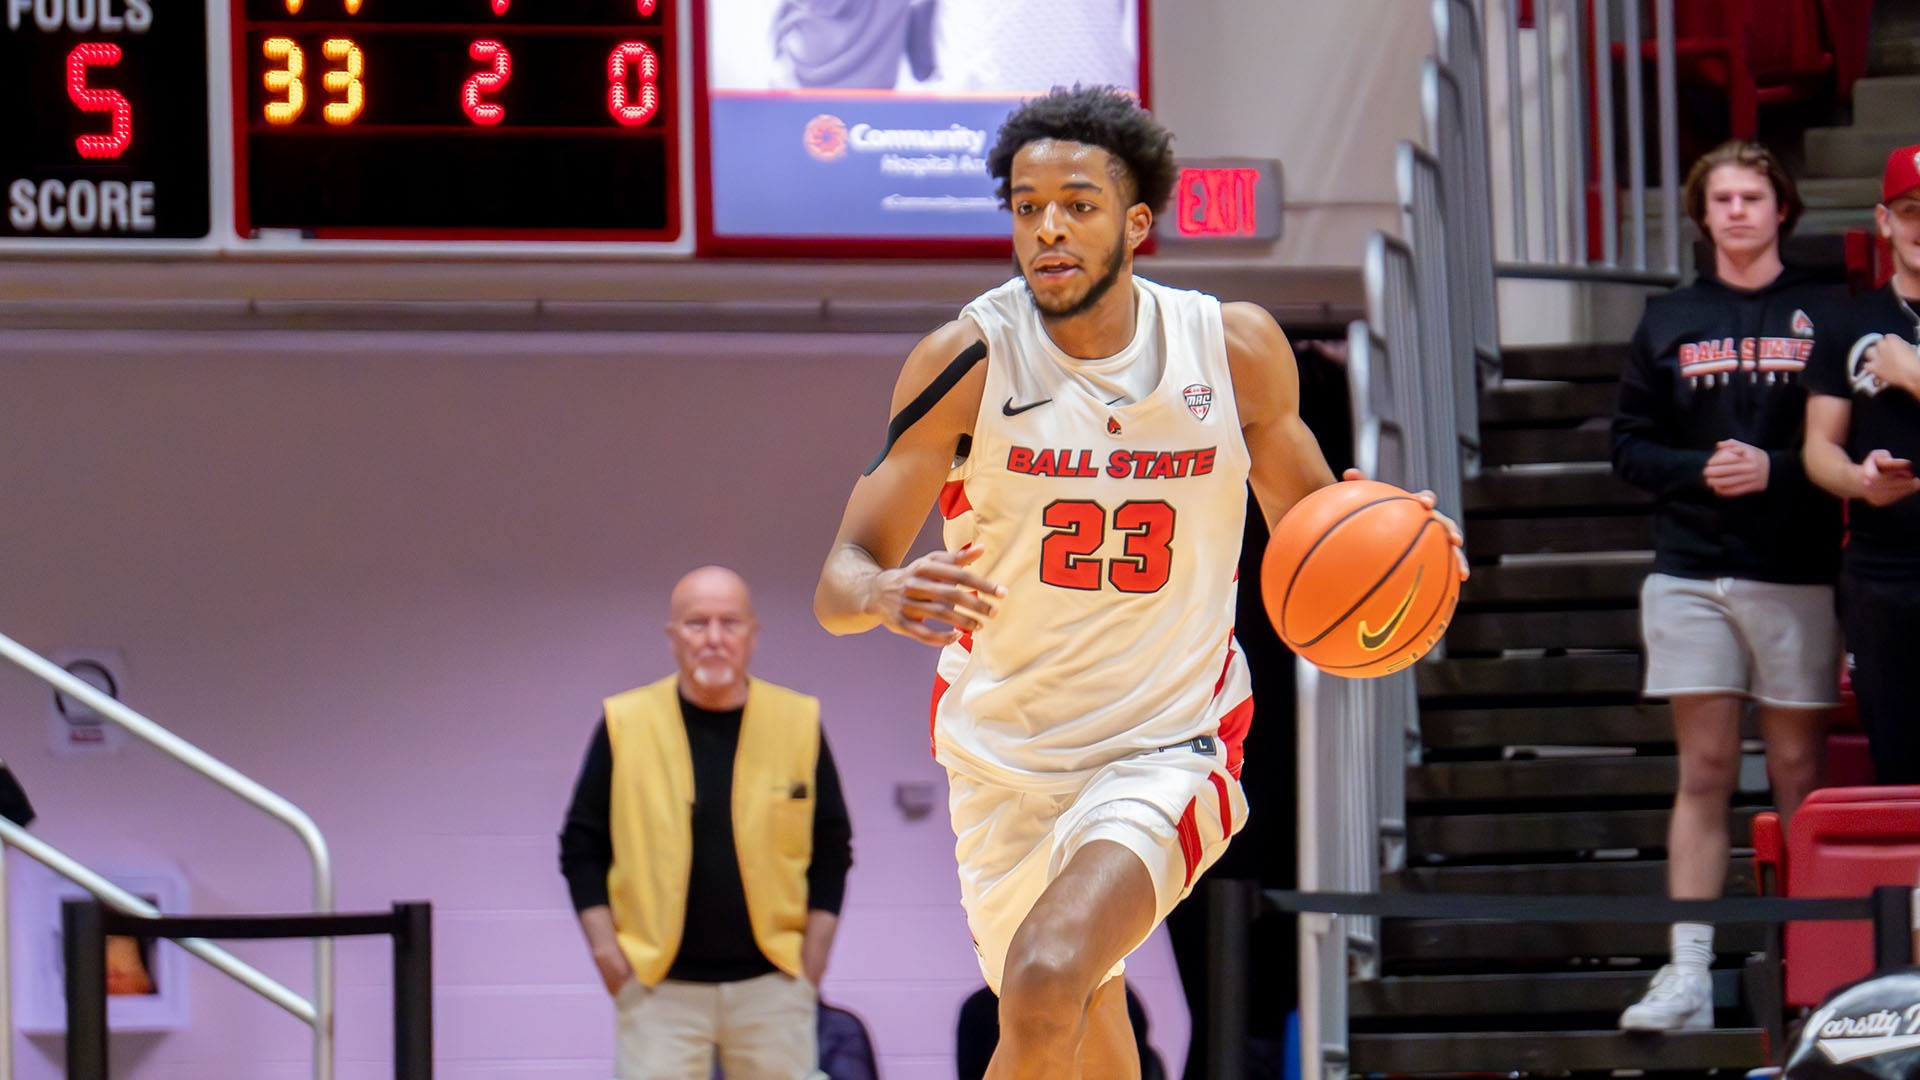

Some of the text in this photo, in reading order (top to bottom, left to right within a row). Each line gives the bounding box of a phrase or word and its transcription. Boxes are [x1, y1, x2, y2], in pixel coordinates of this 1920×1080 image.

[8, 0, 153, 33] FOULS
[263, 38, 659, 127] 33 2 0
[66, 42, 133, 159] 5
[850, 123, 987, 154] Community
[8, 180, 156, 231] SCORE
[1177, 167, 1260, 237] EXIT
[1680, 337, 1815, 366] BALL STATE
[1186, 394, 1212, 406] MAC
[1006, 445, 1217, 479] BALL STATE
[1039, 499, 1177, 594] 23
[1198, 738, 1208, 750] L
